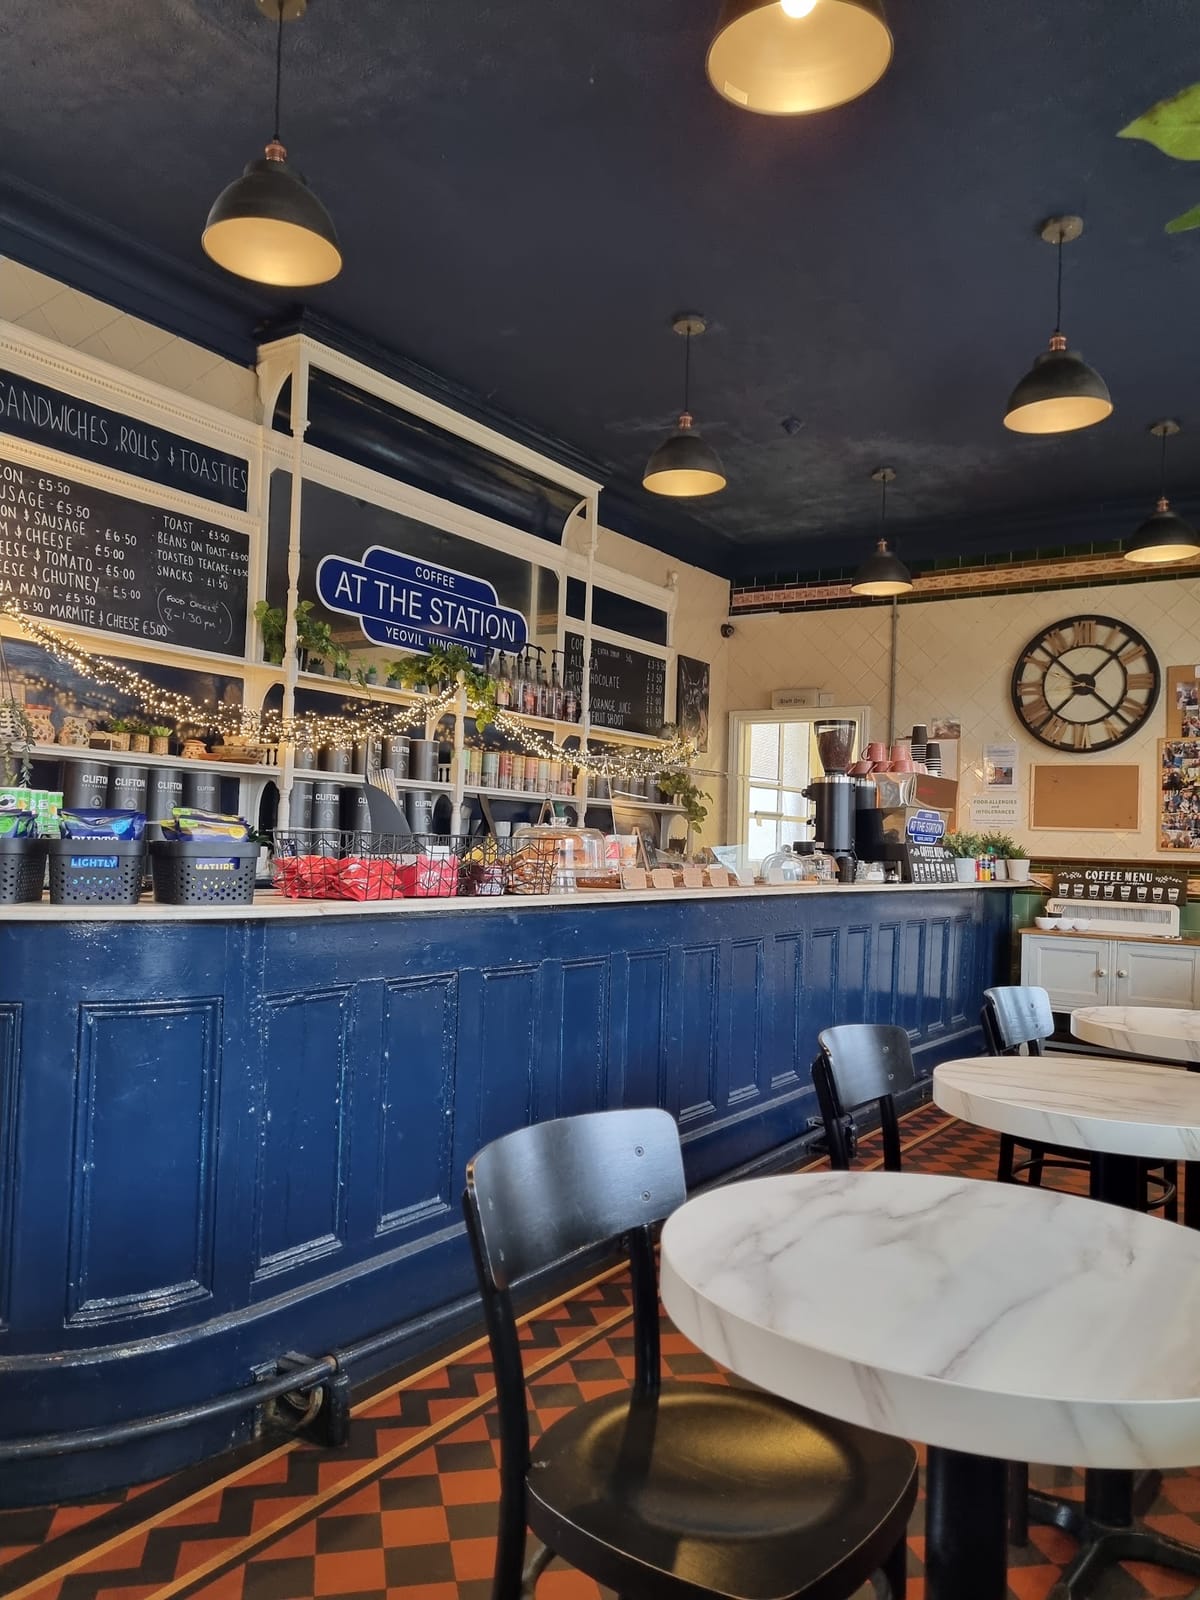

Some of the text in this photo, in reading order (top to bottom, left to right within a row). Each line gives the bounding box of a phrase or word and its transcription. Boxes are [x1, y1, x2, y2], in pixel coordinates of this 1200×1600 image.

[180, 449, 247, 493] TOASTIES
[34, 511, 86, 536] SAUSAGE
[163, 515, 193, 534] TOAST
[26, 527, 72, 552] CHEESE
[157, 531, 187, 549] BEANS
[190, 541, 202, 552] ON
[45, 550, 93, 572] TOMATO
[157, 549, 194, 566] TOASTED
[42, 567, 100, 593] CHUTNEY
[156, 566, 193, 583] SNACKS
[415, 566, 456, 589] COFFEE
[20, 582, 51, 600] MAYO
[334, 570, 516, 643] AT THE STATION
[50, 604, 96, 624] MARMITE
[106, 613, 140, 632] CHEESE
[386, 626, 424, 646] YEOVIL
[590, 673, 620, 689] HOCOLATE
[114, 777, 146, 787] CLIFTON
[70, 858, 117, 868] LIGHTLY
[1085, 870, 1153, 882] COFFEE MENU
